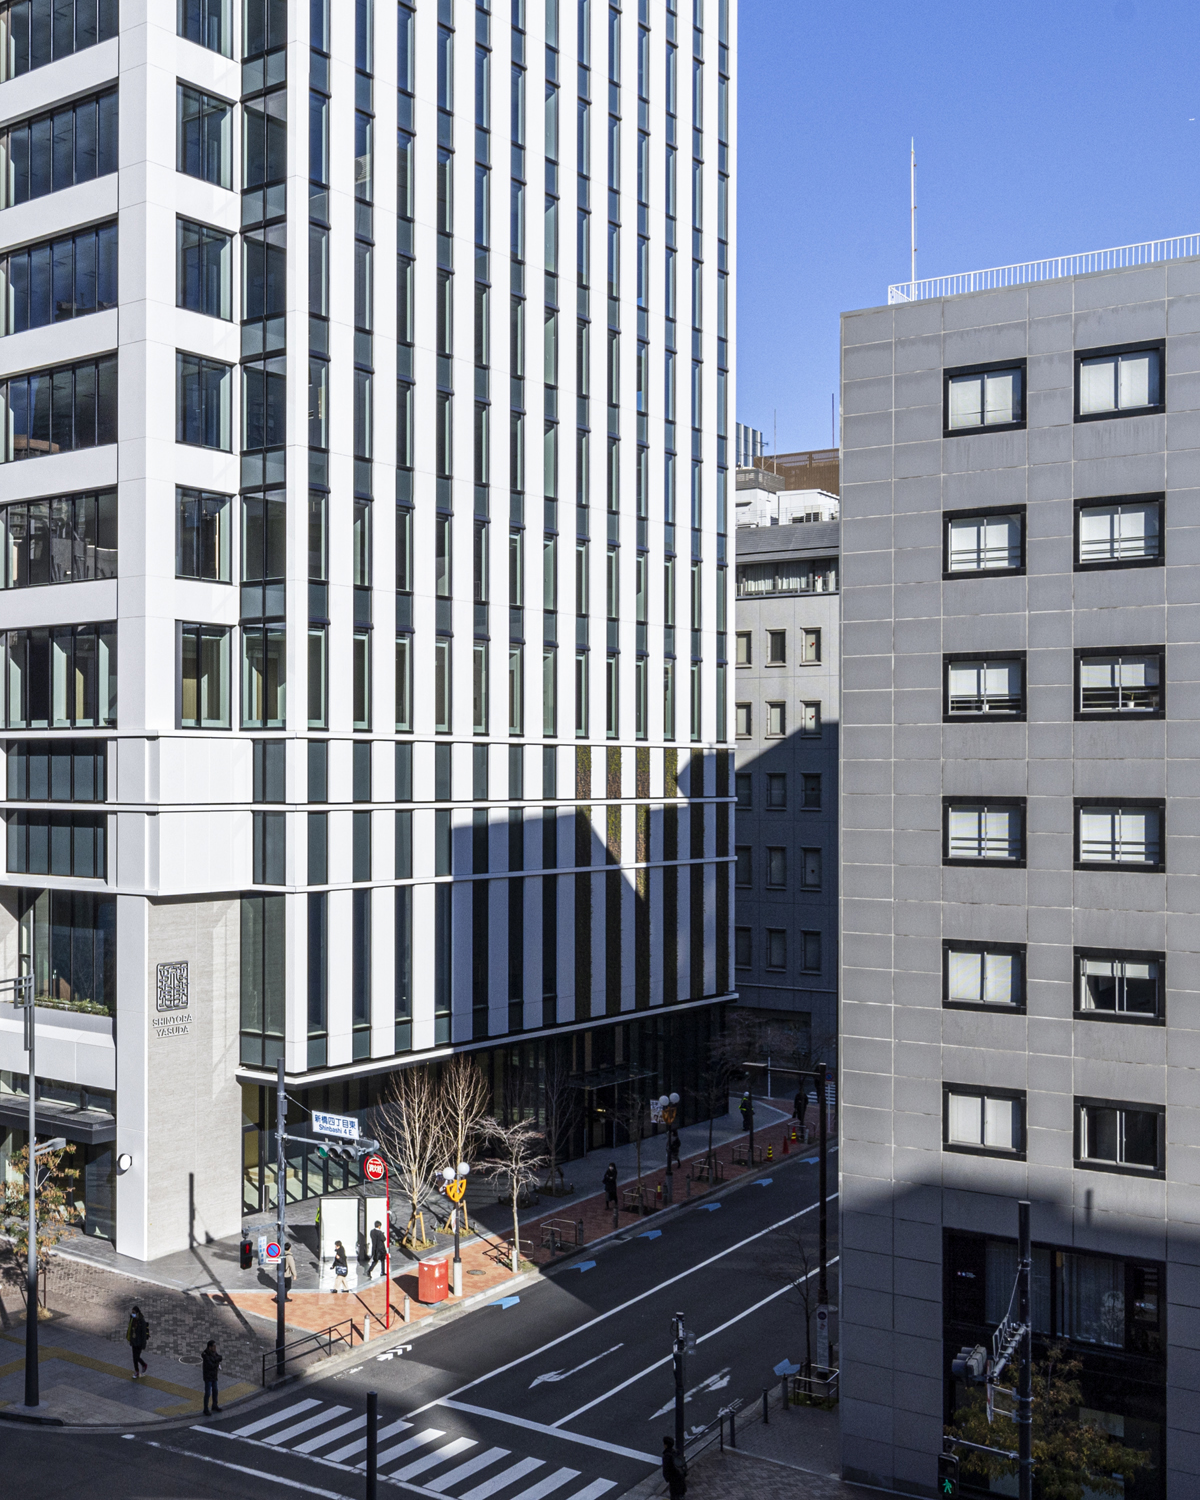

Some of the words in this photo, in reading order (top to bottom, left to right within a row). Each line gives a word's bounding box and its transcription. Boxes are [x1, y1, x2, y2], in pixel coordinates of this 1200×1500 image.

[156, 1025, 189, 1037] YASUDA
[314, 1114, 356, 1129] 新橋四丁目東
[319, 1124, 342, 1134] Shinbashi
